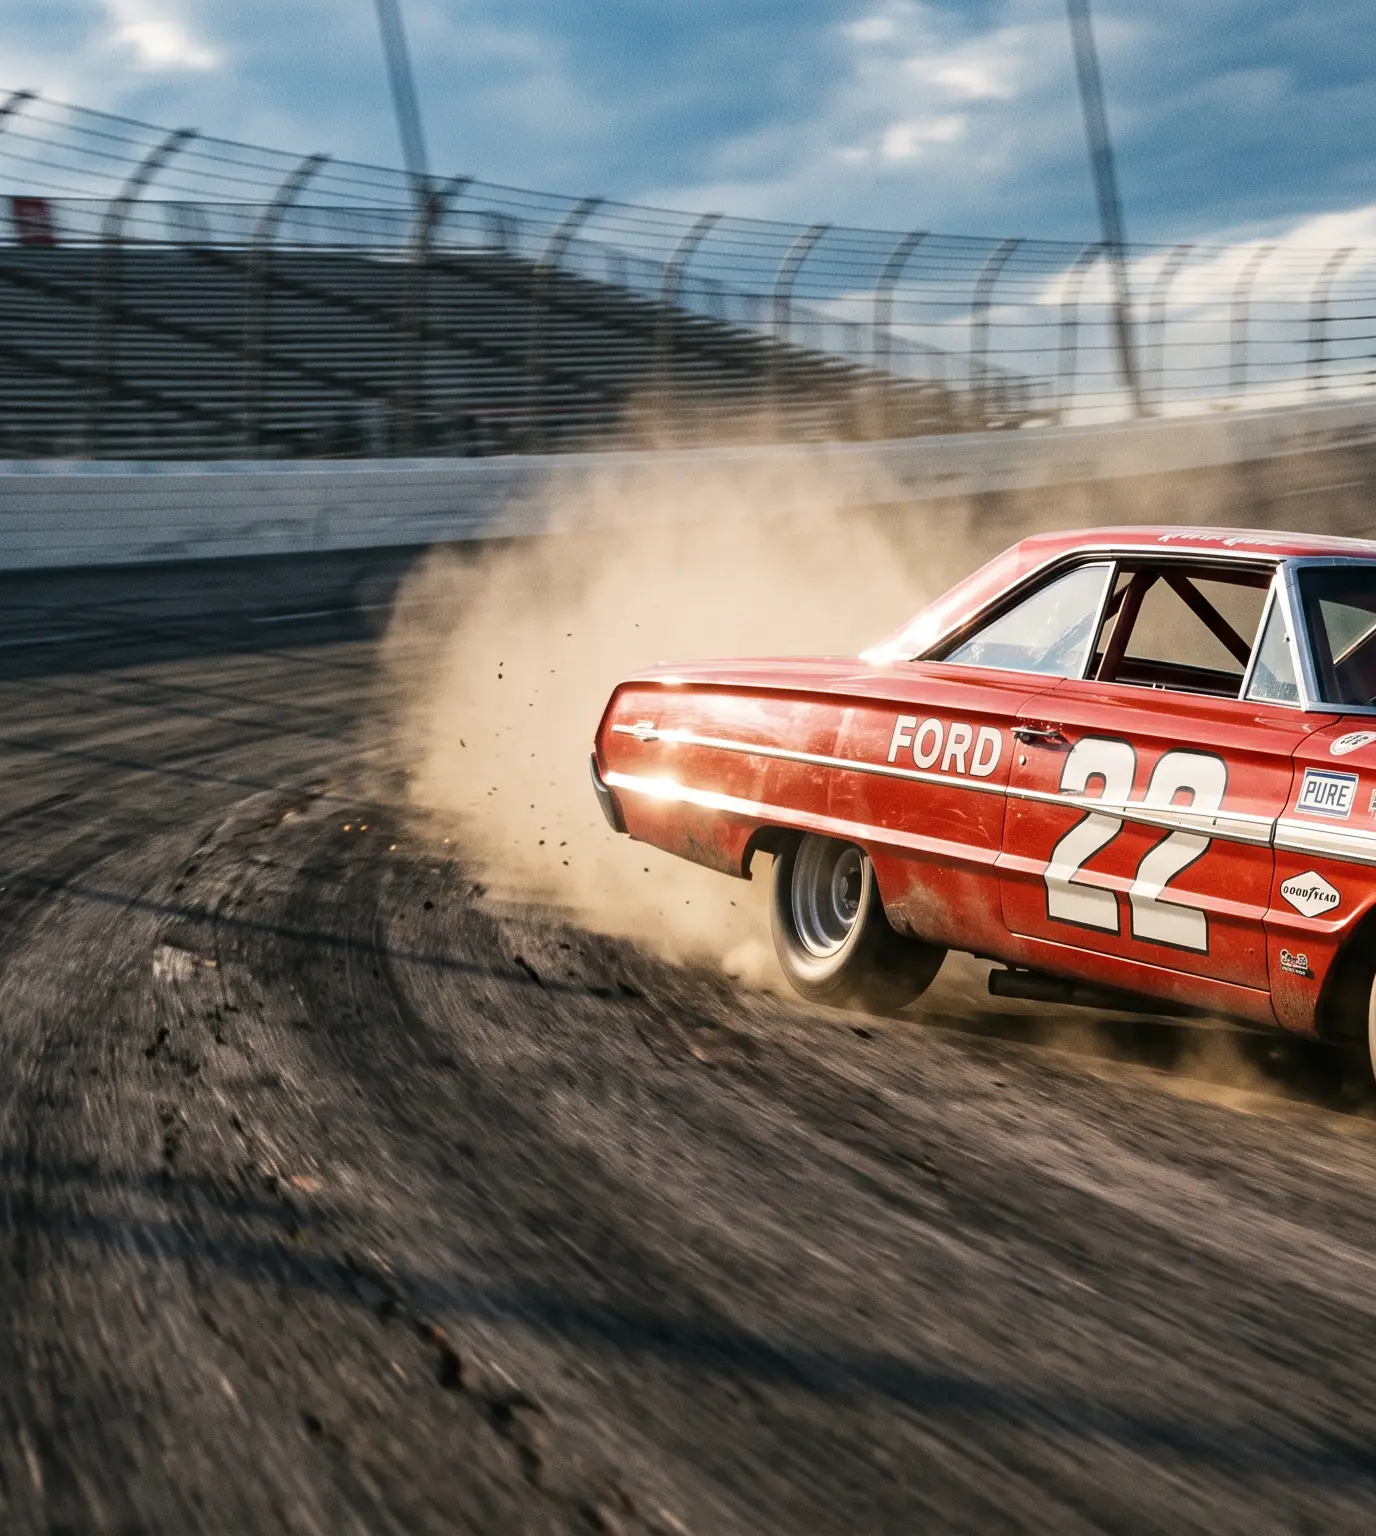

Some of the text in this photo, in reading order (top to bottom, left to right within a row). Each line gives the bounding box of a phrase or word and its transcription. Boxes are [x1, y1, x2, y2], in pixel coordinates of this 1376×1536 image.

[887, 714, 1004, 778] FORD
[1303, 780, 1351, 808] PURE
[1043, 734, 1229, 956] 22
